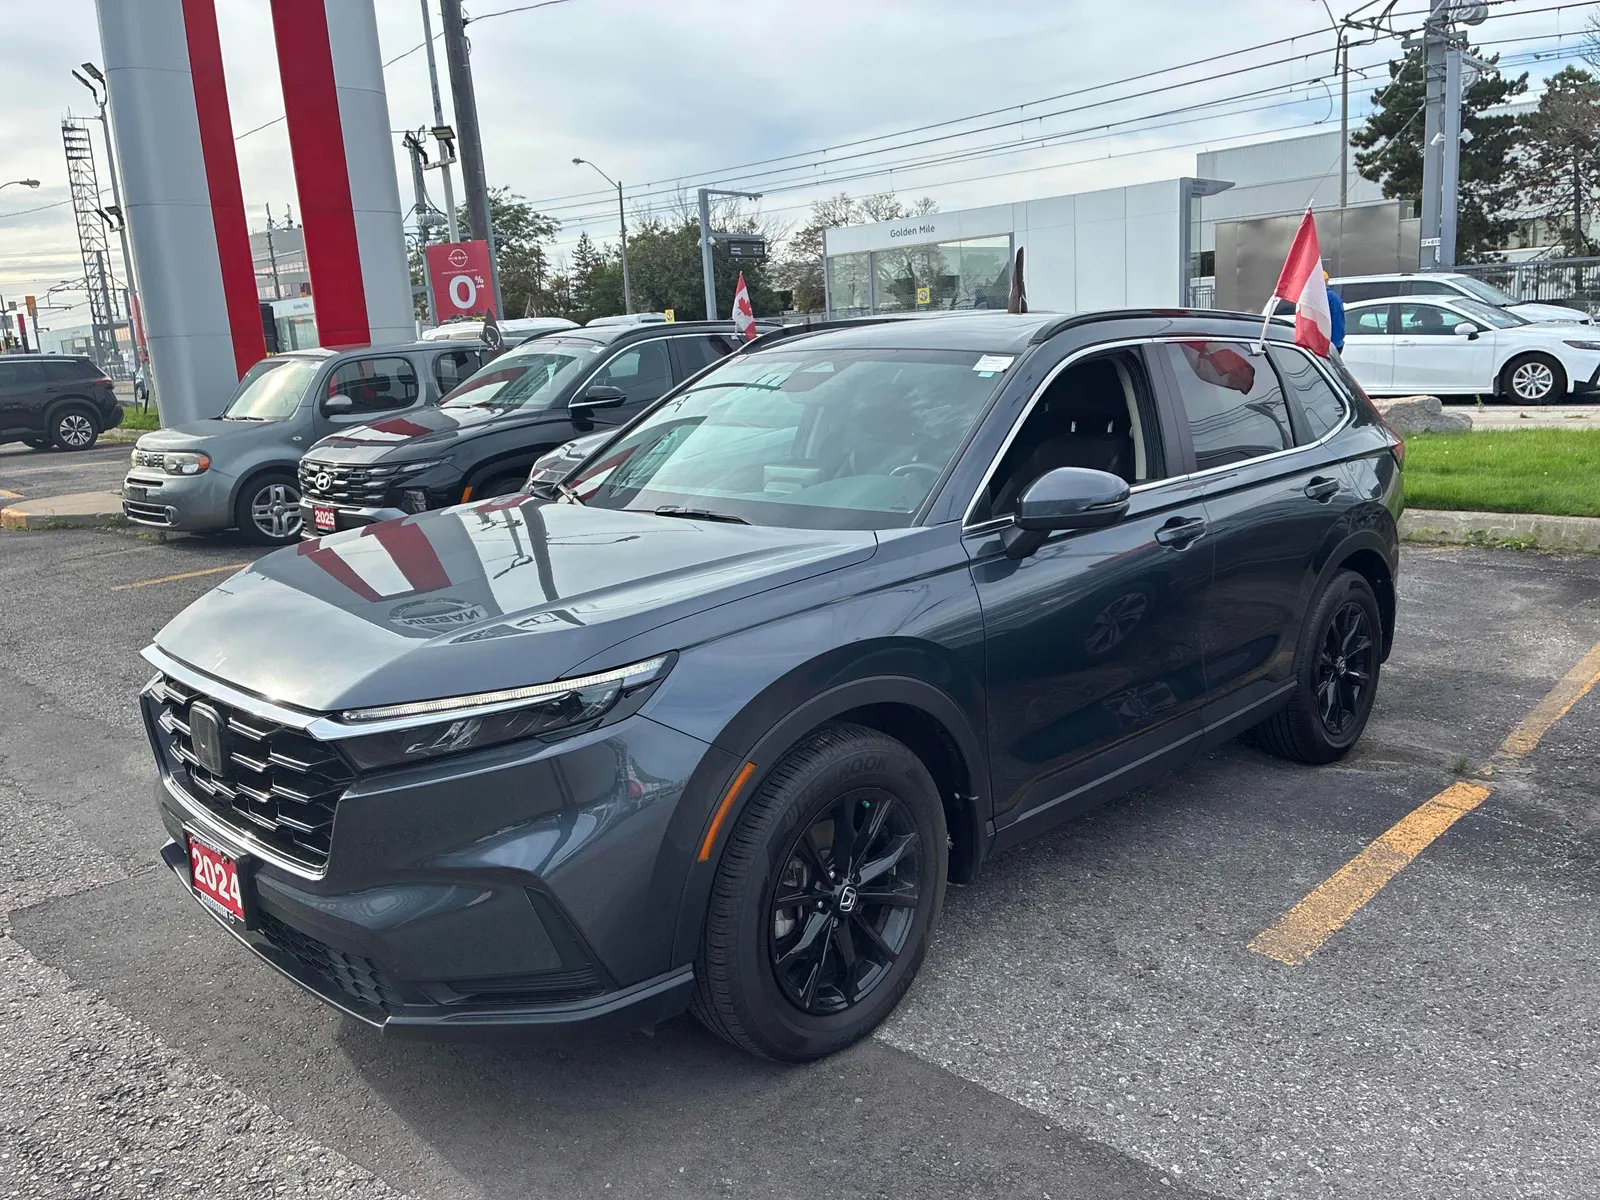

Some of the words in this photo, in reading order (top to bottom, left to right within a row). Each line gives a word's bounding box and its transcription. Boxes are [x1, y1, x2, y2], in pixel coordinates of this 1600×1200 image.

[890, 228, 917, 238] Golden
[919, 224, 936, 234] Mile
[315, 510, 335, 526] 2025
[192, 847, 242, 910] 2024
